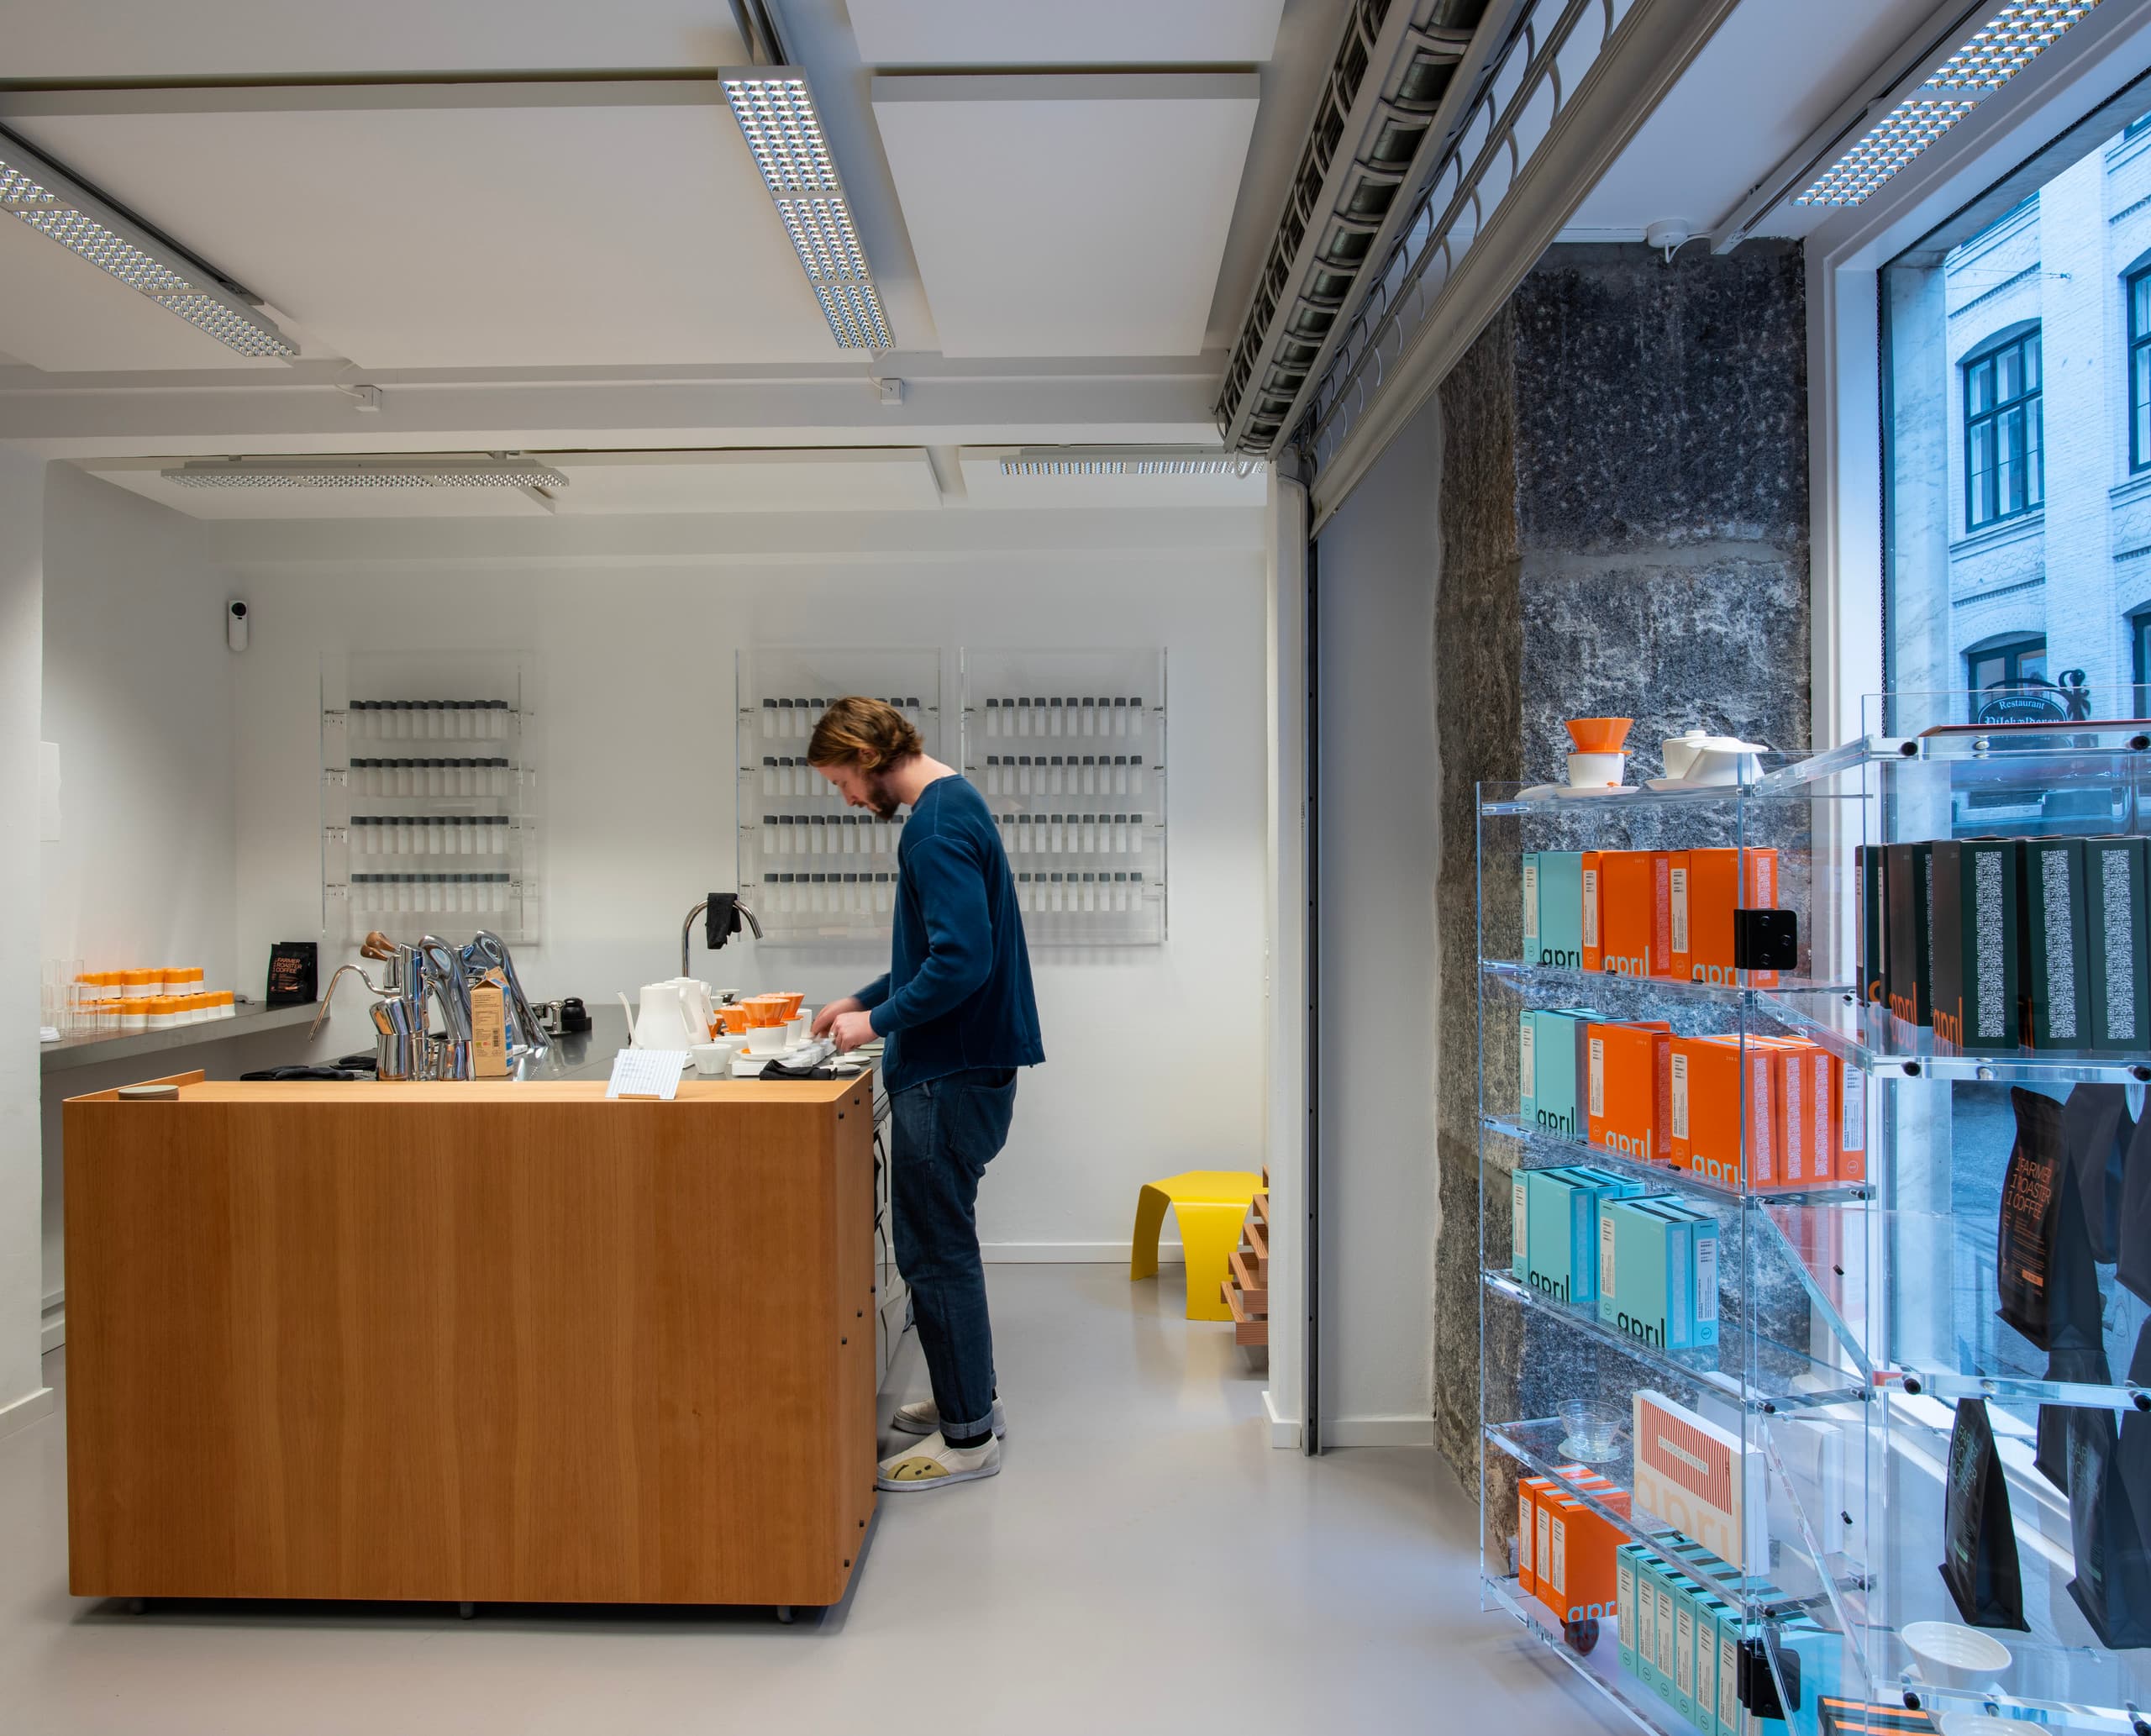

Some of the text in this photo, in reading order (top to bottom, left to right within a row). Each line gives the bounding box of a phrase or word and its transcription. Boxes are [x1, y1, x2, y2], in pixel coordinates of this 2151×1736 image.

[1999, 699, 2045, 710] Restaurant
[1543, 947, 1582, 968] apri
[1605, 945, 1649, 976] april
[1537, 1106, 1575, 1135] april
[1606, 1128, 1651, 1162] april
[1691, 1154, 1738, 1184] apri
[2010, 1174, 2017, 1189] 1
[2020, 1158, 2052, 1185] FARMER
[2006, 1191, 2044, 1220] 1 COFFEE
[1530, 1270, 1570, 1303] april
[1617, 1312, 1665, 1349] april
[1567, 1600, 1616, 1623] apr
